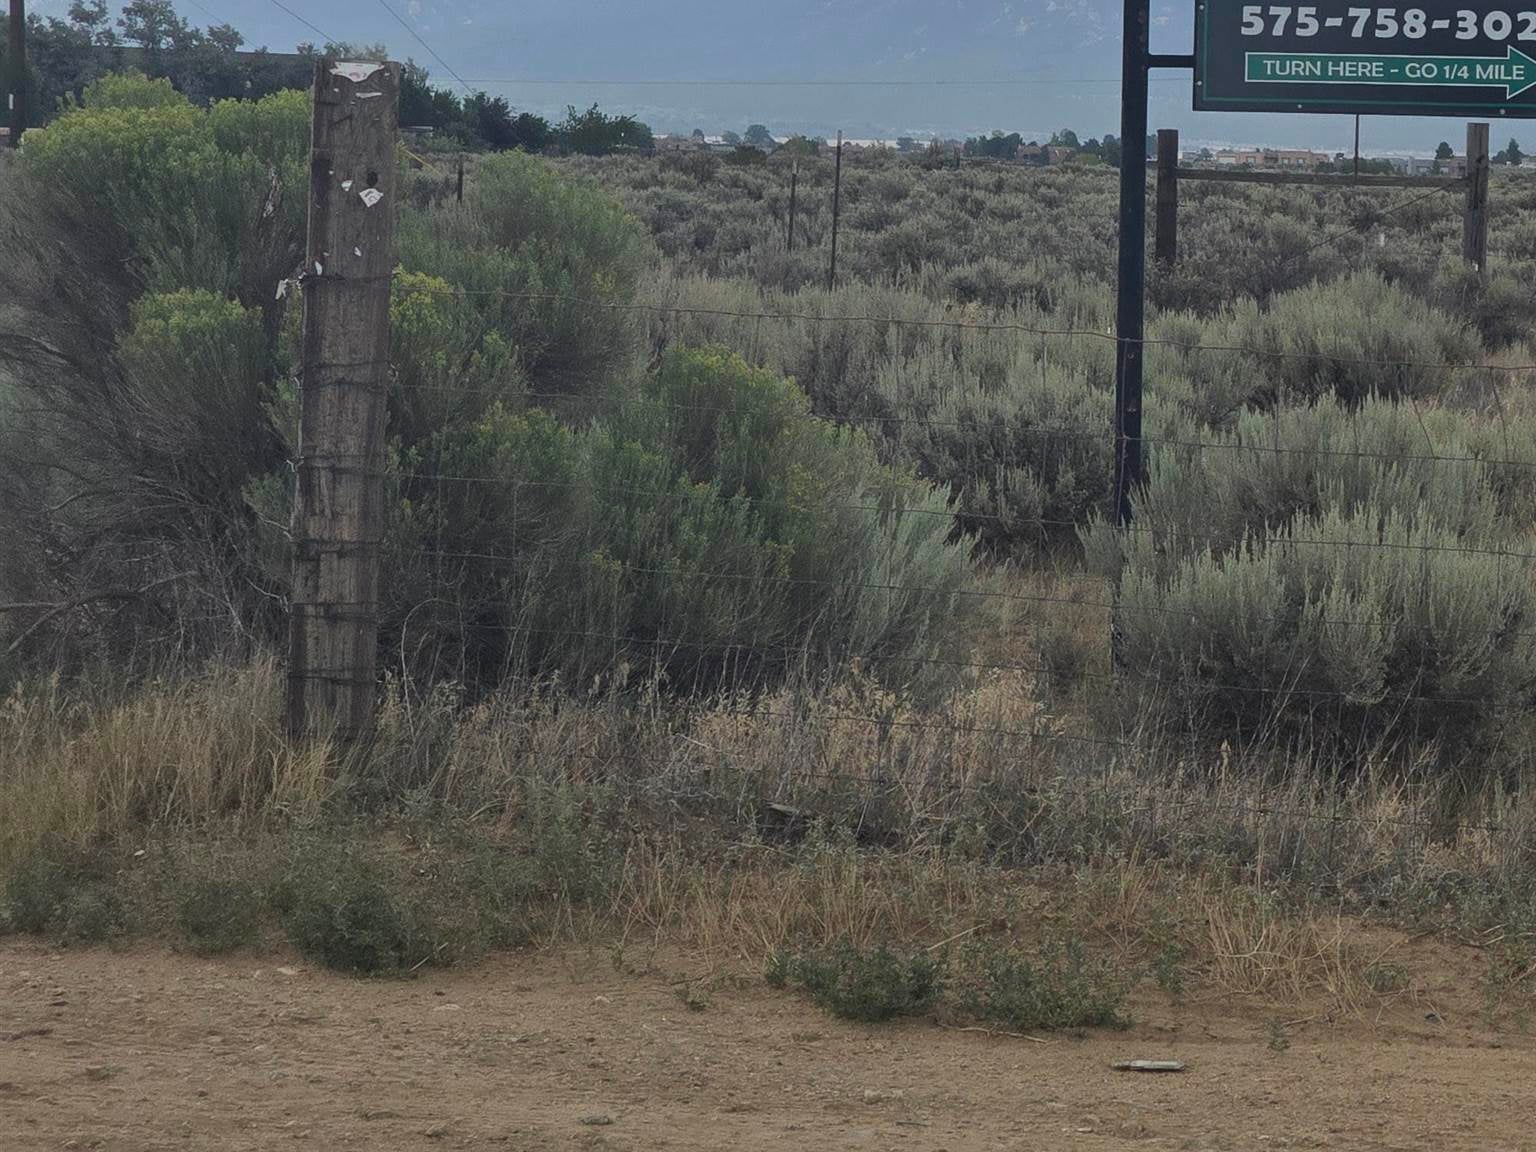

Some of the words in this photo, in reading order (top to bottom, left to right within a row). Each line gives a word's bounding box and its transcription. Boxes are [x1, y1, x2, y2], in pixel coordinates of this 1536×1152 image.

[1264, 60, 1321, 77] TURN
[1328, 61, 1384, 78] HERE
[1405, 64, 1438, 79] GO
[1444, 65, 1469, 80] 1/4
[1476, 66, 1525, 81] MILE
